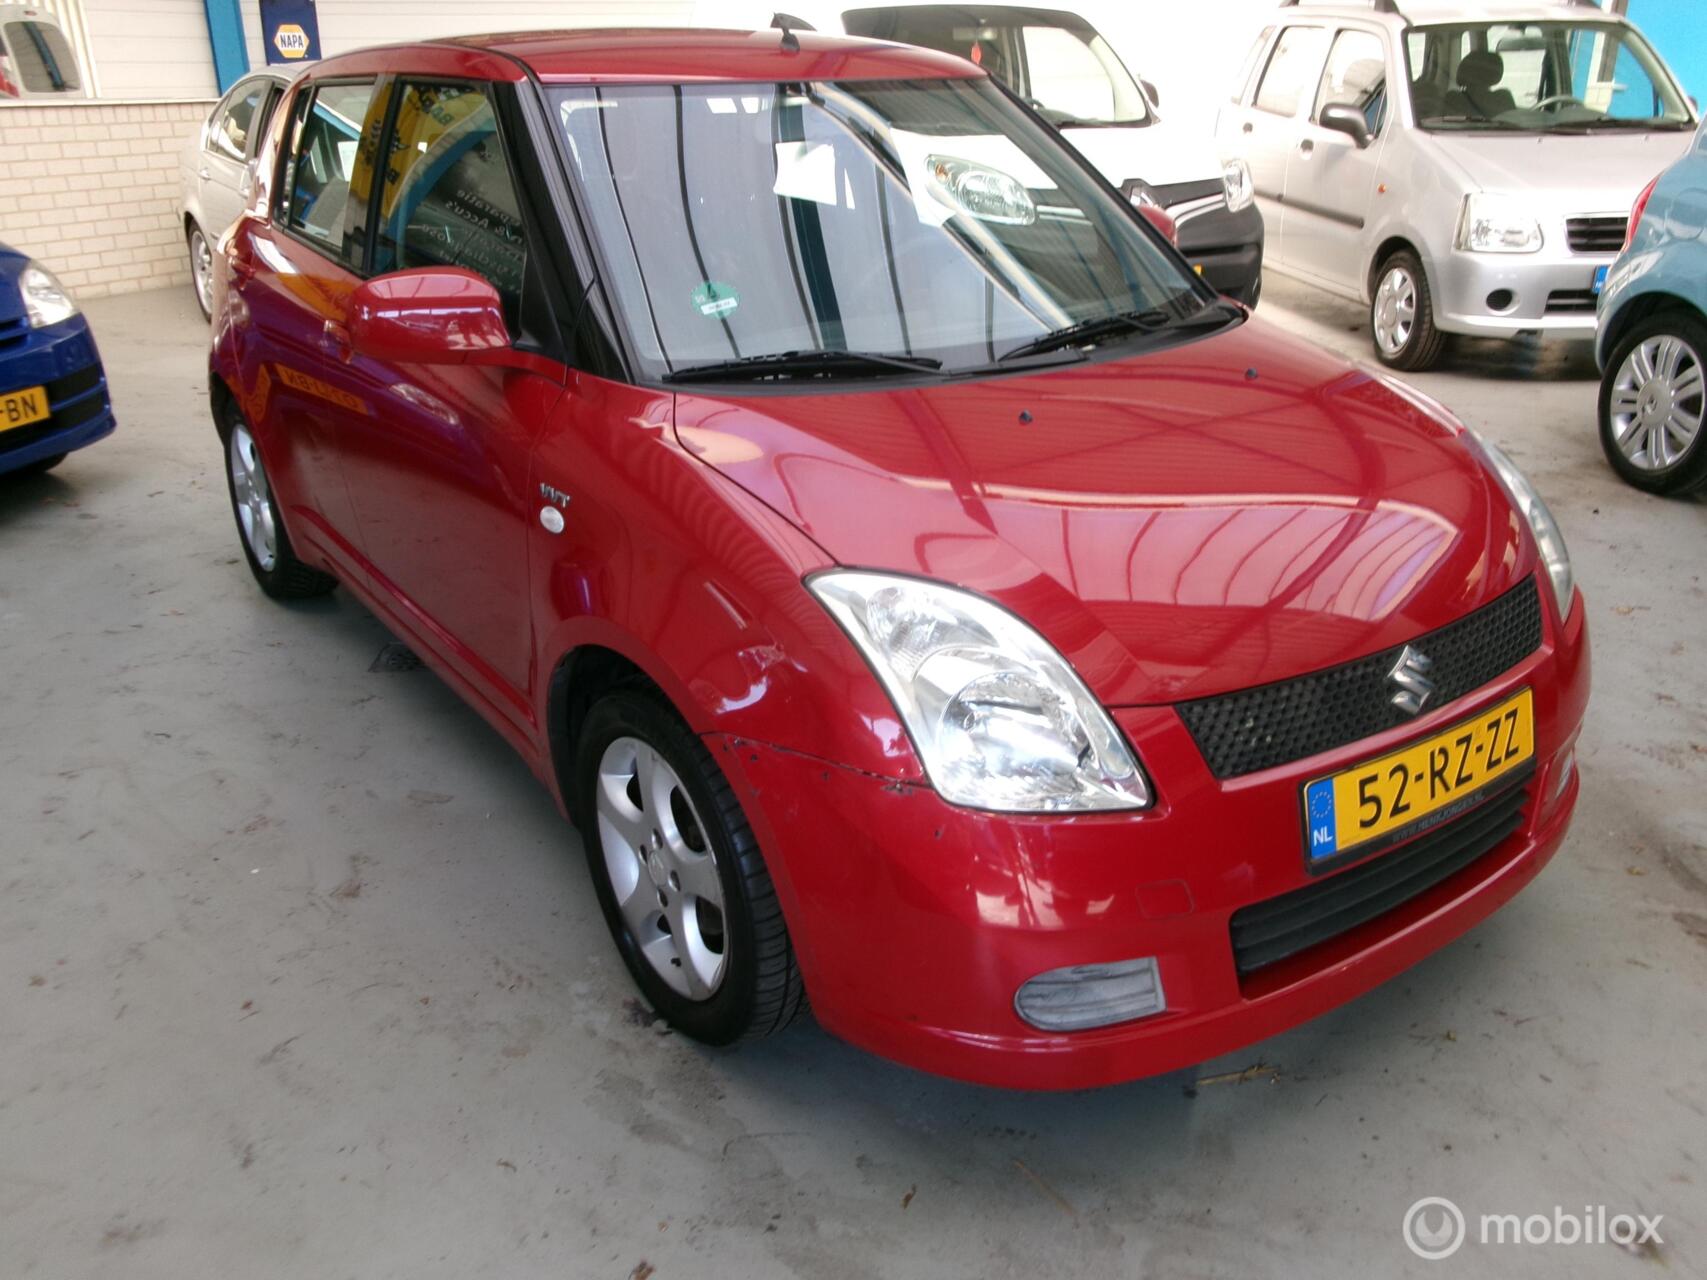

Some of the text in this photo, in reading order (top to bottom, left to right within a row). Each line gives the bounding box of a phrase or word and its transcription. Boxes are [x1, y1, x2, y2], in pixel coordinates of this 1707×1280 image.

[280, 33, 304, 49] NAPA
[1358, 708, 1520, 829] 52-RZ-ZZ
[1313, 826, 1333, 847] NL
